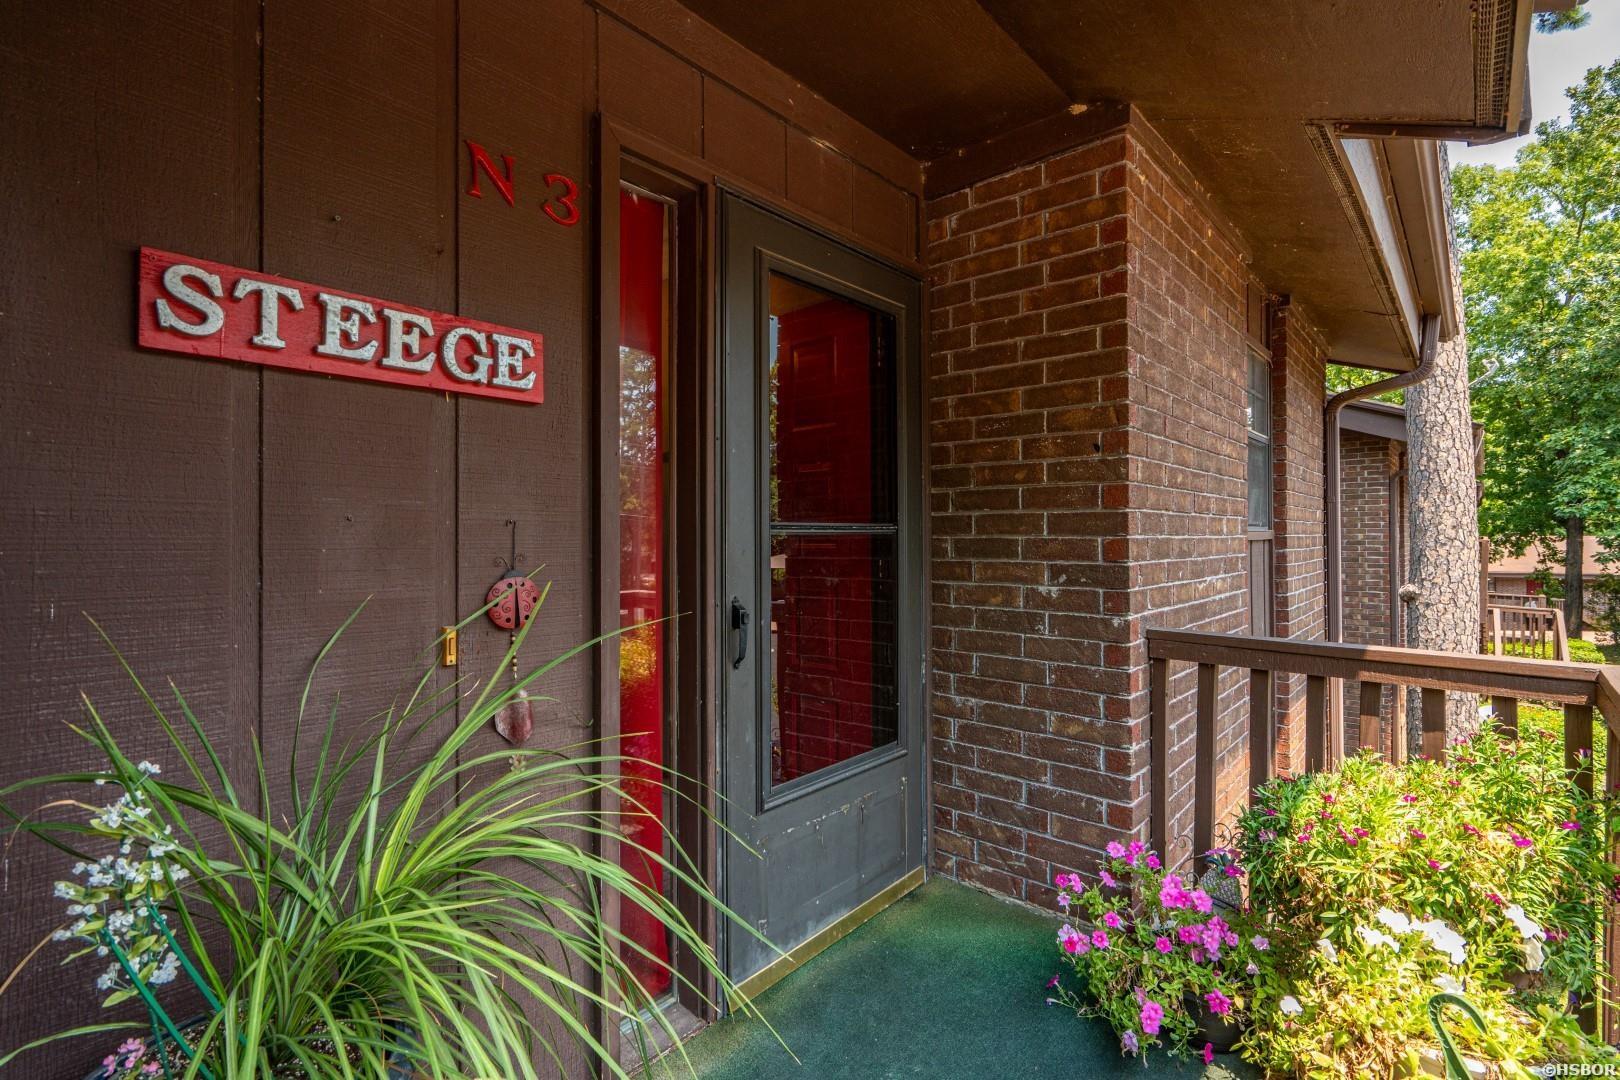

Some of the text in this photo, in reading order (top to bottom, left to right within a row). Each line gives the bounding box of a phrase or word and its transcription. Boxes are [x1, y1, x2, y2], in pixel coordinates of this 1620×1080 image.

[464, 139, 581, 227] N 3
[155, 263, 537, 391] STEEGE
